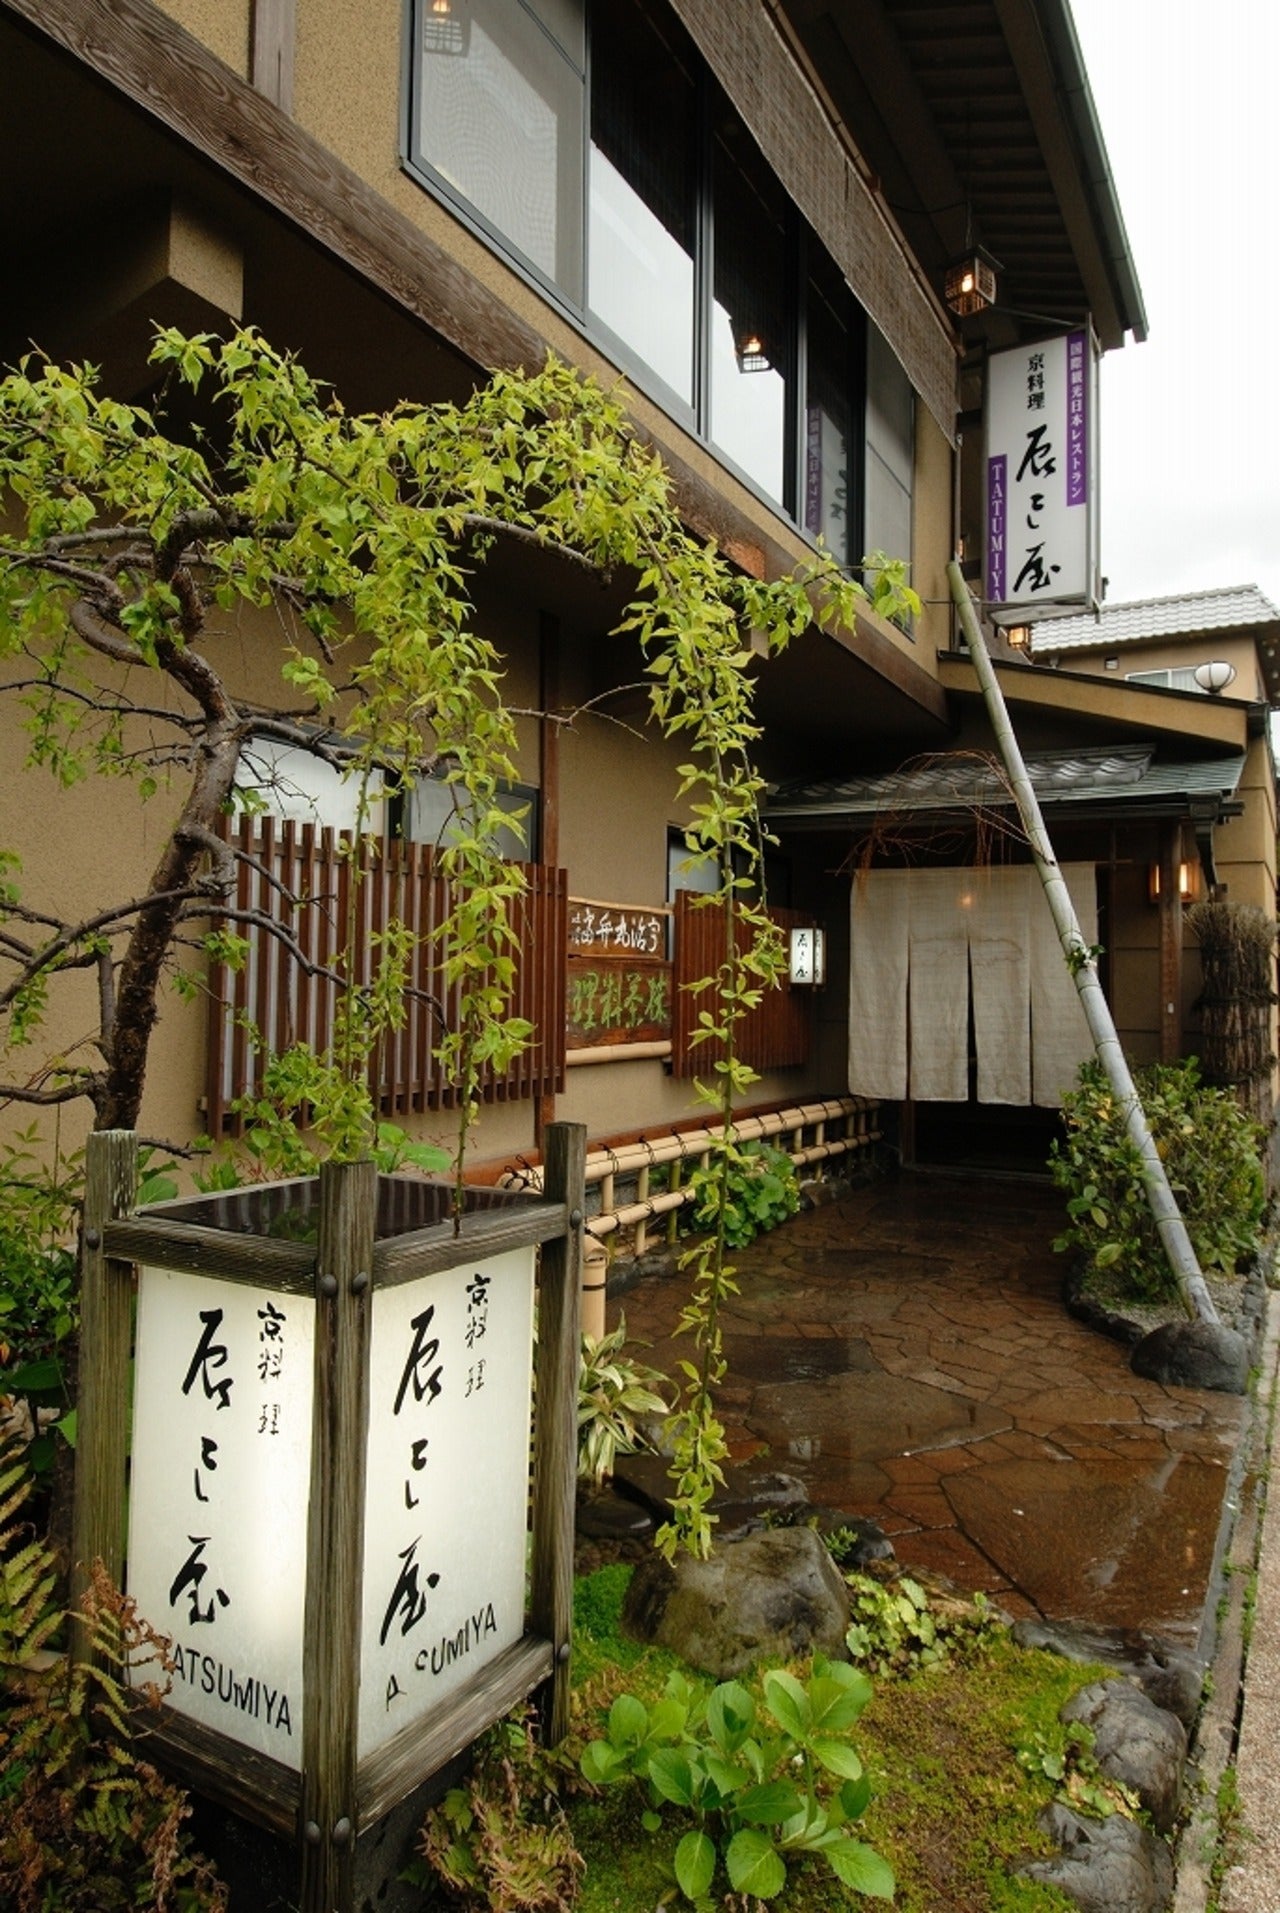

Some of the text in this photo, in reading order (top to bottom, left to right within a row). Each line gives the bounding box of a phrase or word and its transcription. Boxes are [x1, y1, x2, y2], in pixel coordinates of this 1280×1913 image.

[1026, 353, 1045, 411] 京料理
[1070, 341, 1084, 498] 国際観光日本レストラン
[991, 464, 1003, 602] TATUMIYA
[257, 1301, 287, 1436] 京料理
[465, 1273, 492, 1398] 京料理
[173, 1643, 292, 1736] ATSUMIYA
